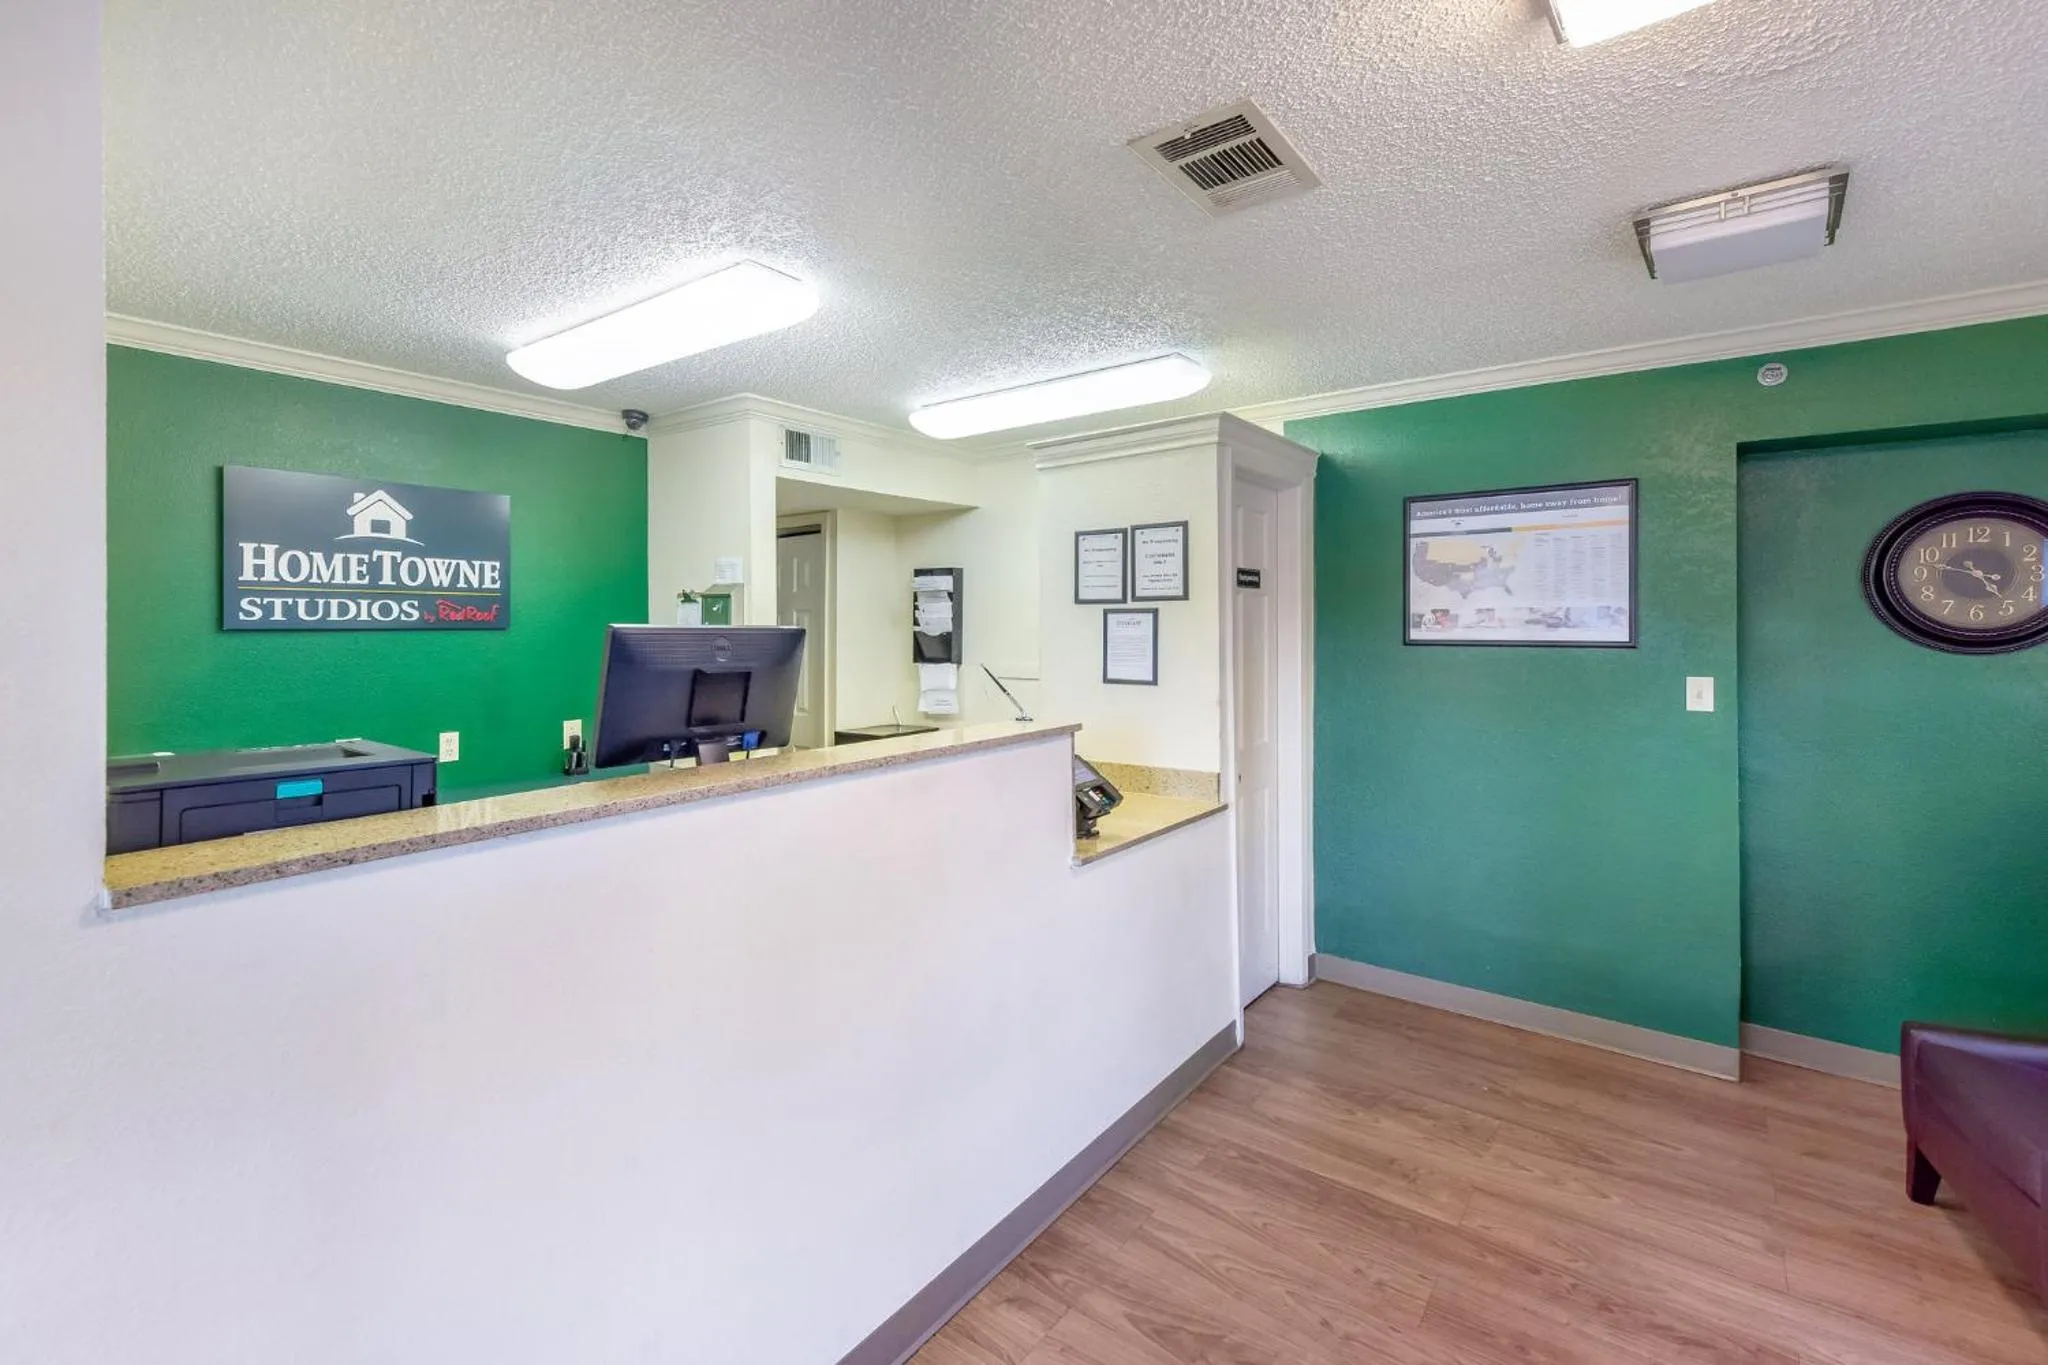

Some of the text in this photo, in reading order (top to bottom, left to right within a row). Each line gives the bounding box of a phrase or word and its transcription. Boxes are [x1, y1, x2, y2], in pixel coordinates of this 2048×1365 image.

[1545, 500, 1567, 508] away
[1569, 498, 1592, 506] from
[1942, 532, 1957, 548] 11
[1967, 526, 1991, 543] 12
[2002, 531, 2011, 547] 1
[1919, 547, 1940, 564] 10
[2022, 544, 2037, 562] 2
[1913, 566, 1928, 583] 9
[2030, 564, 2045, 582] 3
[1920, 585, 1935, 601] 8
[2021, 585, 2037, 602] 4
[238, 597, 419, 622] STUDIOS
[1941, 600, 1954, 615] 7
[1969, 604, 1985, 621] 6
[1998, 600, 2015, 616] 5
